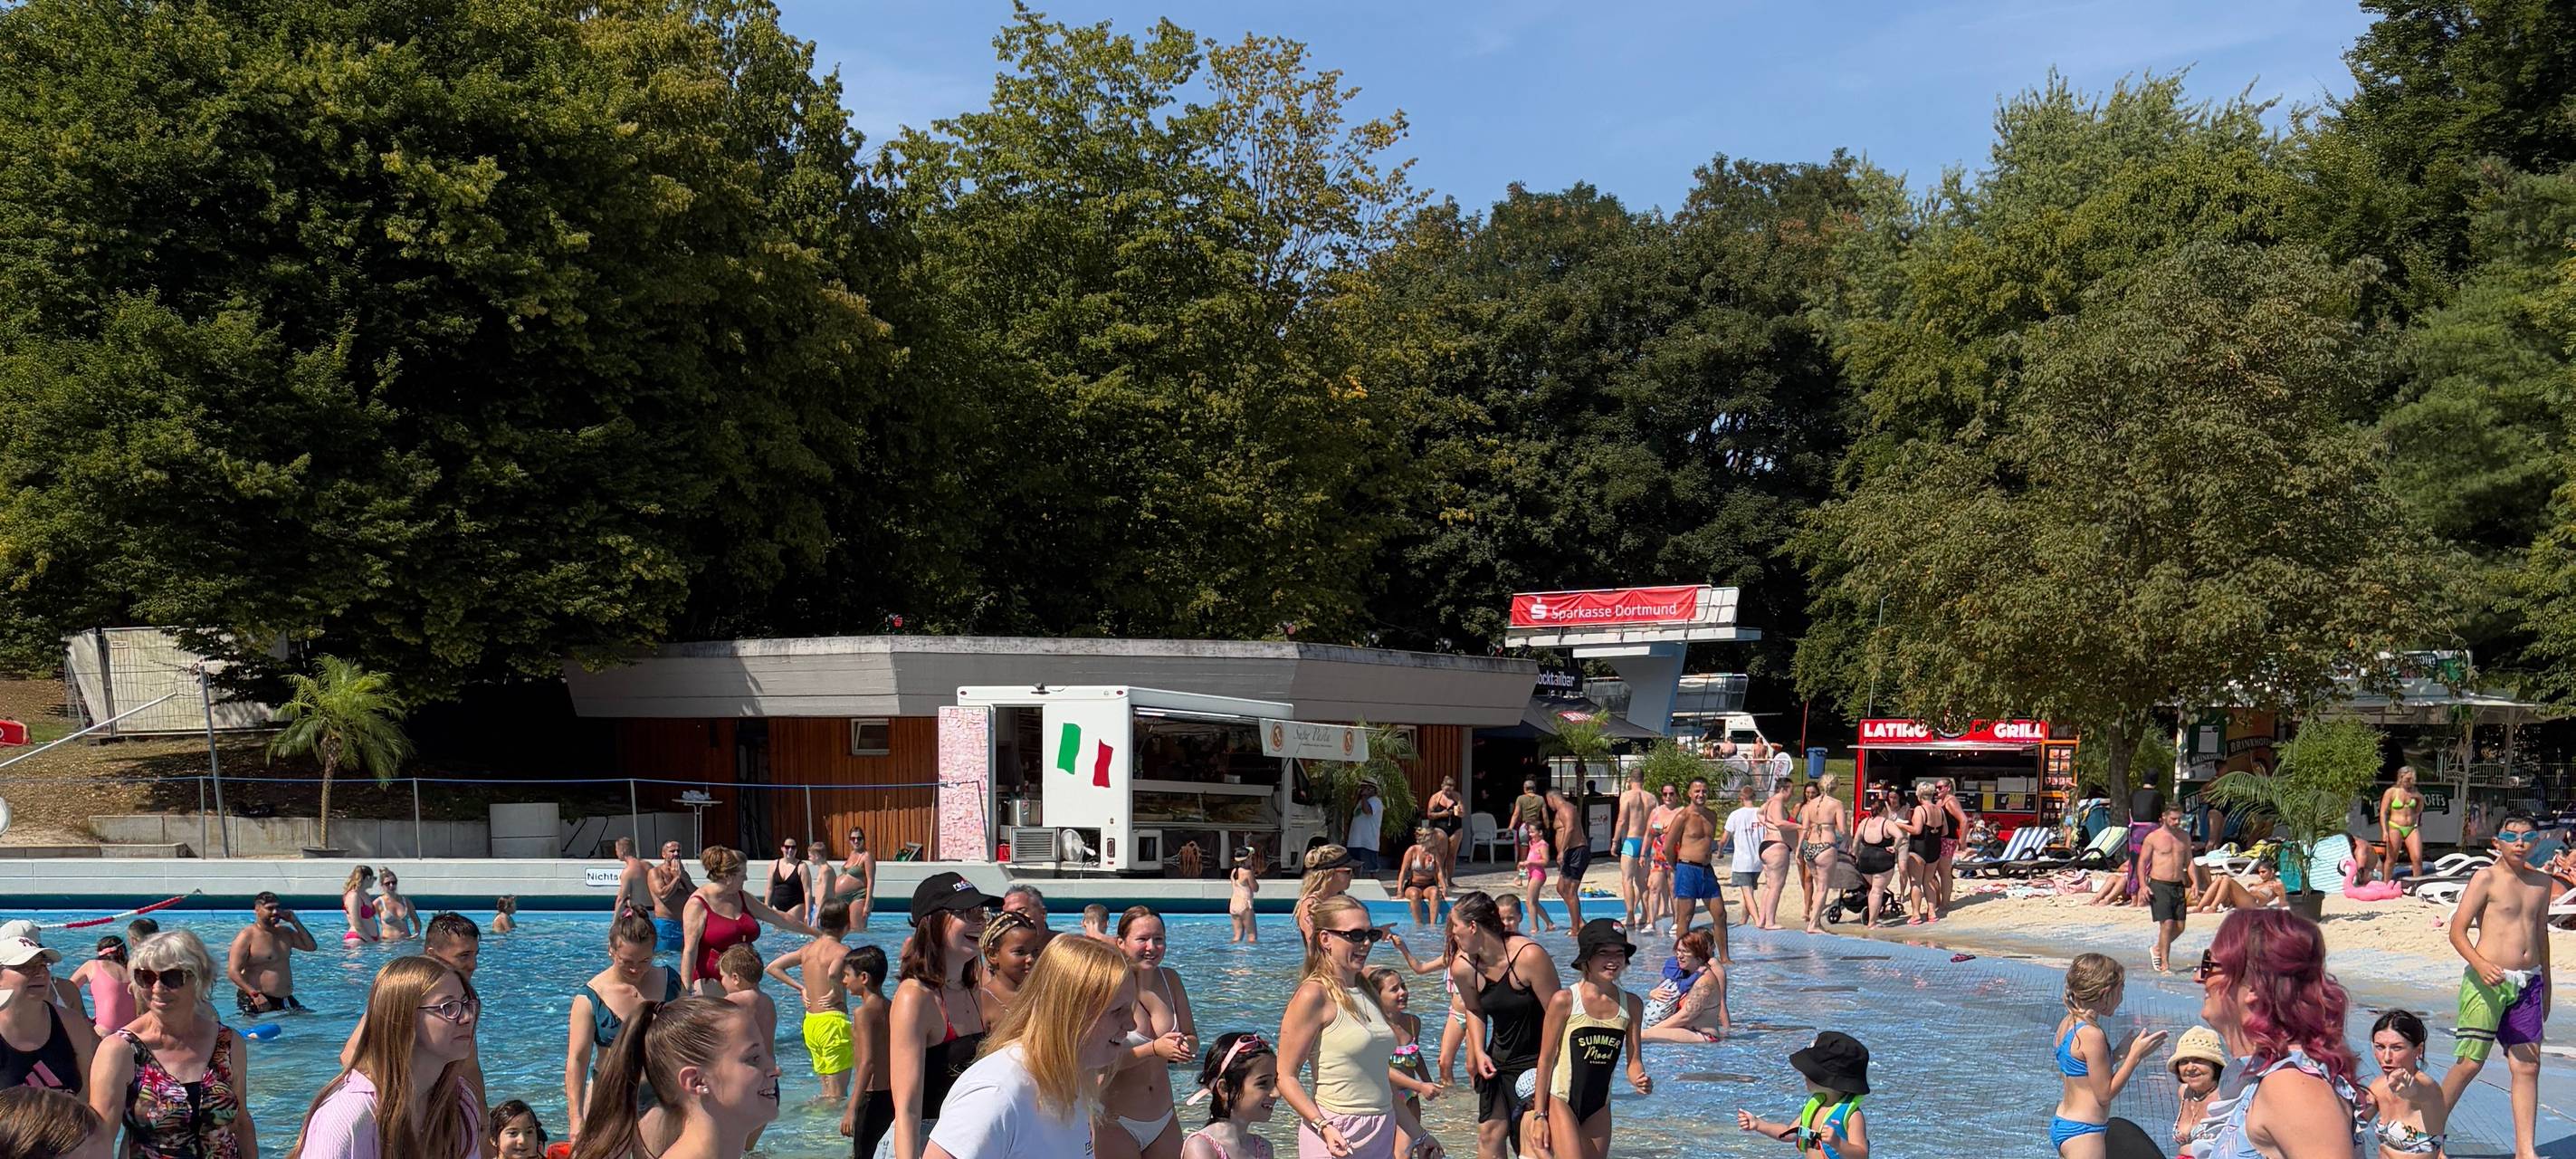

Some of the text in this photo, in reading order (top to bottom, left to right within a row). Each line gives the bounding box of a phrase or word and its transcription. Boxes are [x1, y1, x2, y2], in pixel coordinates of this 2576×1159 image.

[1551, 606, 1611, 621] Sparkasse
[1616, 603, 1677, 618] Dortmund
[1536, 671, 1575, 686] ocktailbar
[1993, 723, 2043, 739] GRILL
[587, 872, 621, 881] Nichts
[1578, 1034, 1621, 1049] SUMMER
[1584, 1046, 1613, 1059] Mood
